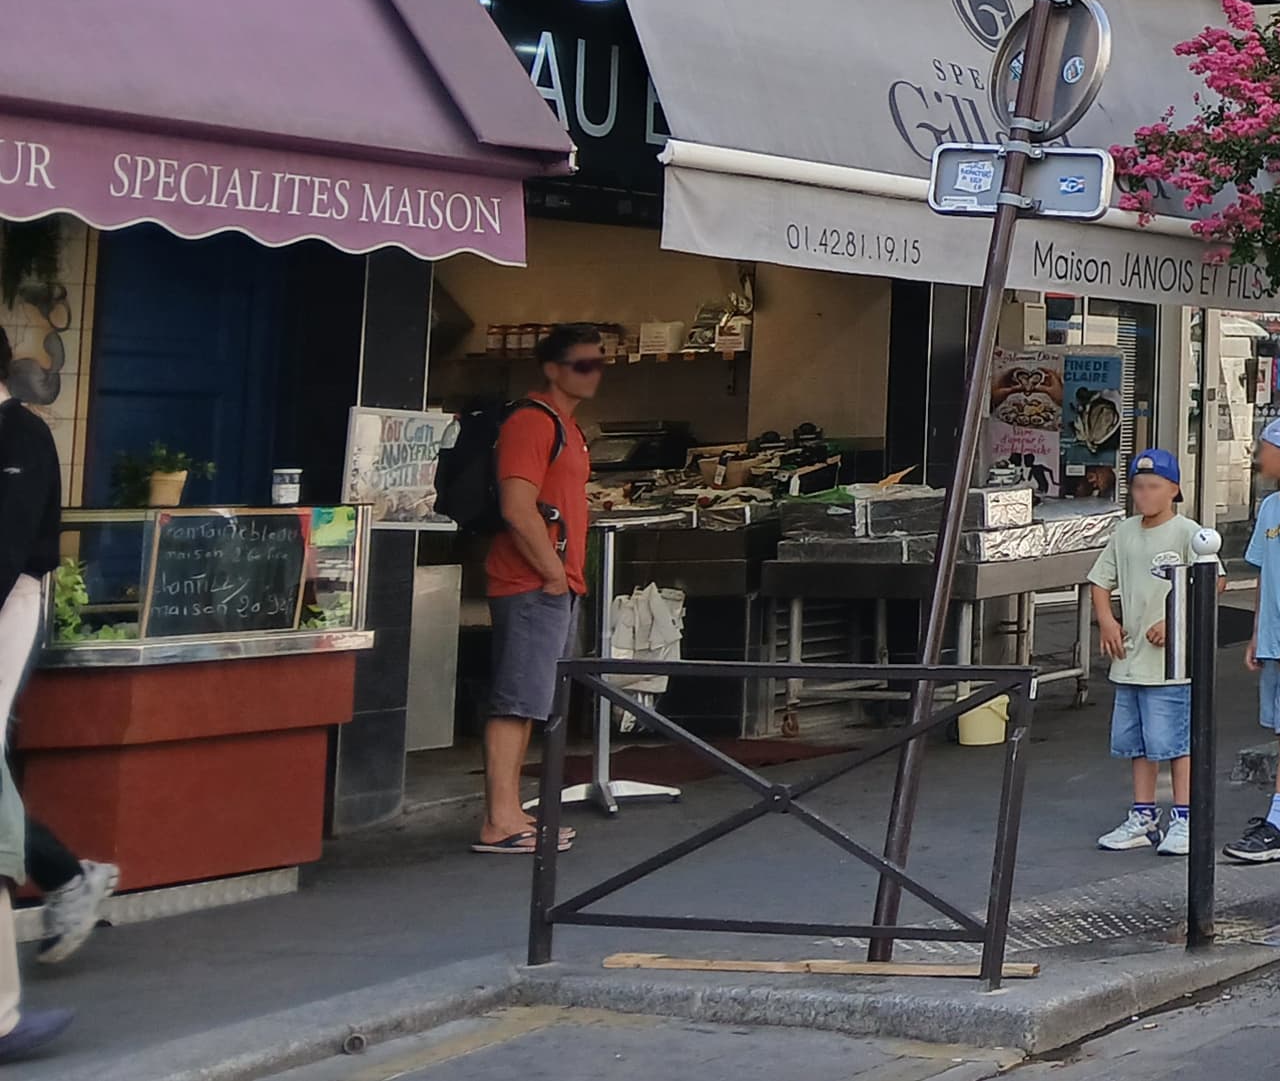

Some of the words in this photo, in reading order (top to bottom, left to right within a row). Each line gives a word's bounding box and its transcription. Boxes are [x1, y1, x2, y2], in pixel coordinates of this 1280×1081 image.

[109, 152, 351, 221] SPECIALITES
[359, 183, 502, 236] MAISON
[786, 223, 921, 265] 01.42.81.19.15
[1033, 239, 1111, 285] Maison
[1120, 254, 1194, 294] JANOIS
[1200, 262, 1223, 296] ET
[1226, 265, 1265, 301] FILS
[1063, 371, 1109, 383] CLAIRE
[1094, 359, 1111, 372] DE
